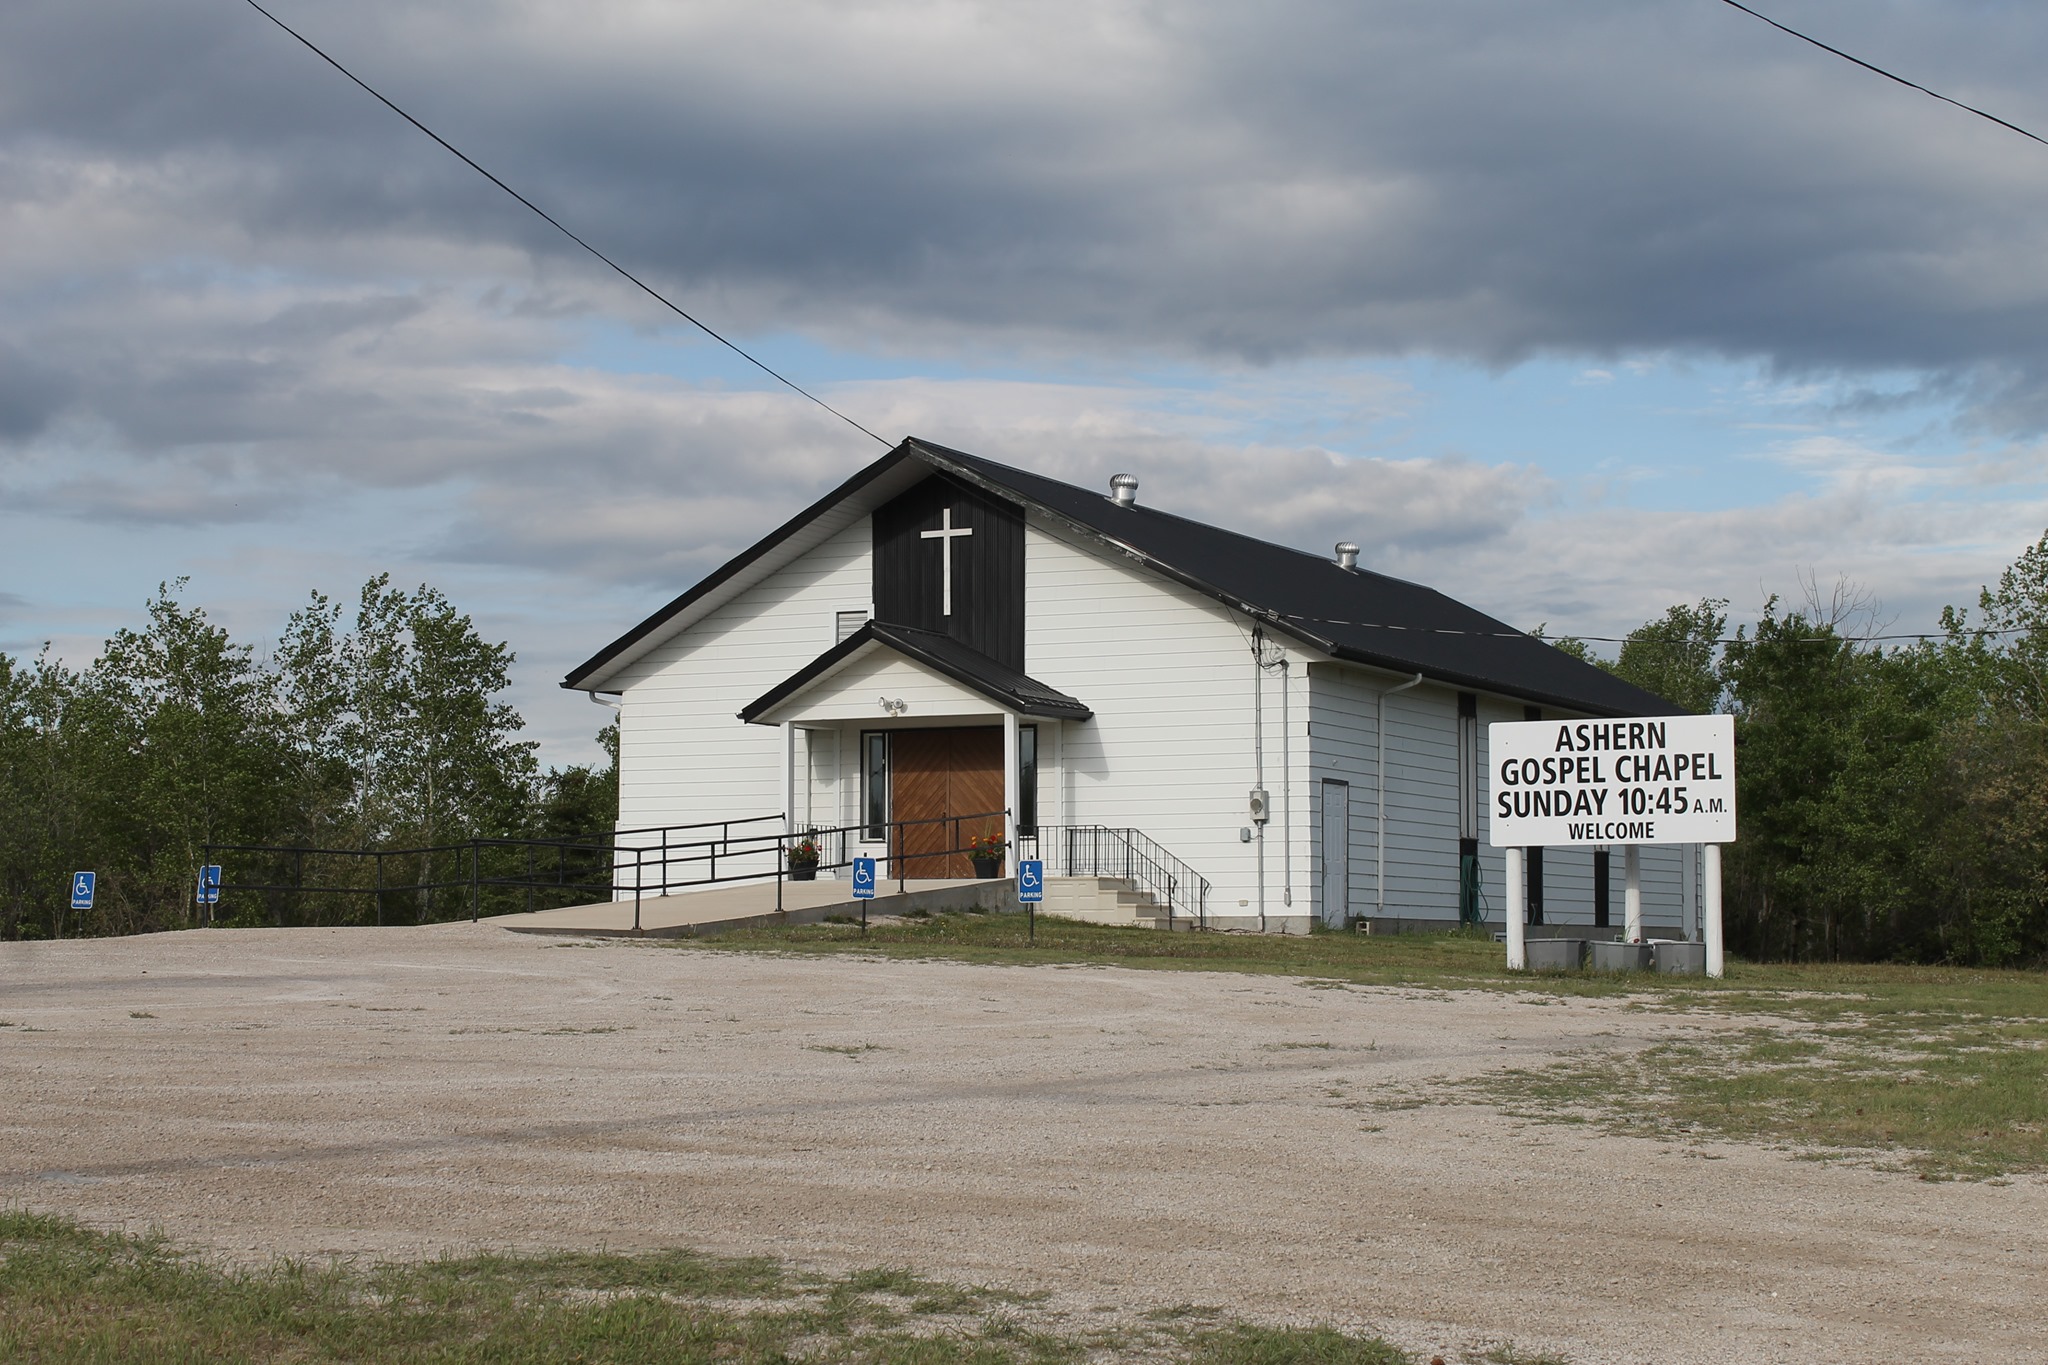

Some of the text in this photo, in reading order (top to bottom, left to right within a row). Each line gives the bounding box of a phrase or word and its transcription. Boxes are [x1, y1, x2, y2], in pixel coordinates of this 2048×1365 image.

[1555, 722, 1666, 752] ASHERN
[1500, 753, 1722, 786] GOSPEL CHAPEL
[1498, 787, 1728, 819] SUNDAY 10:45 A.M.
[1567, 821, 1655, 840] WELCOME
